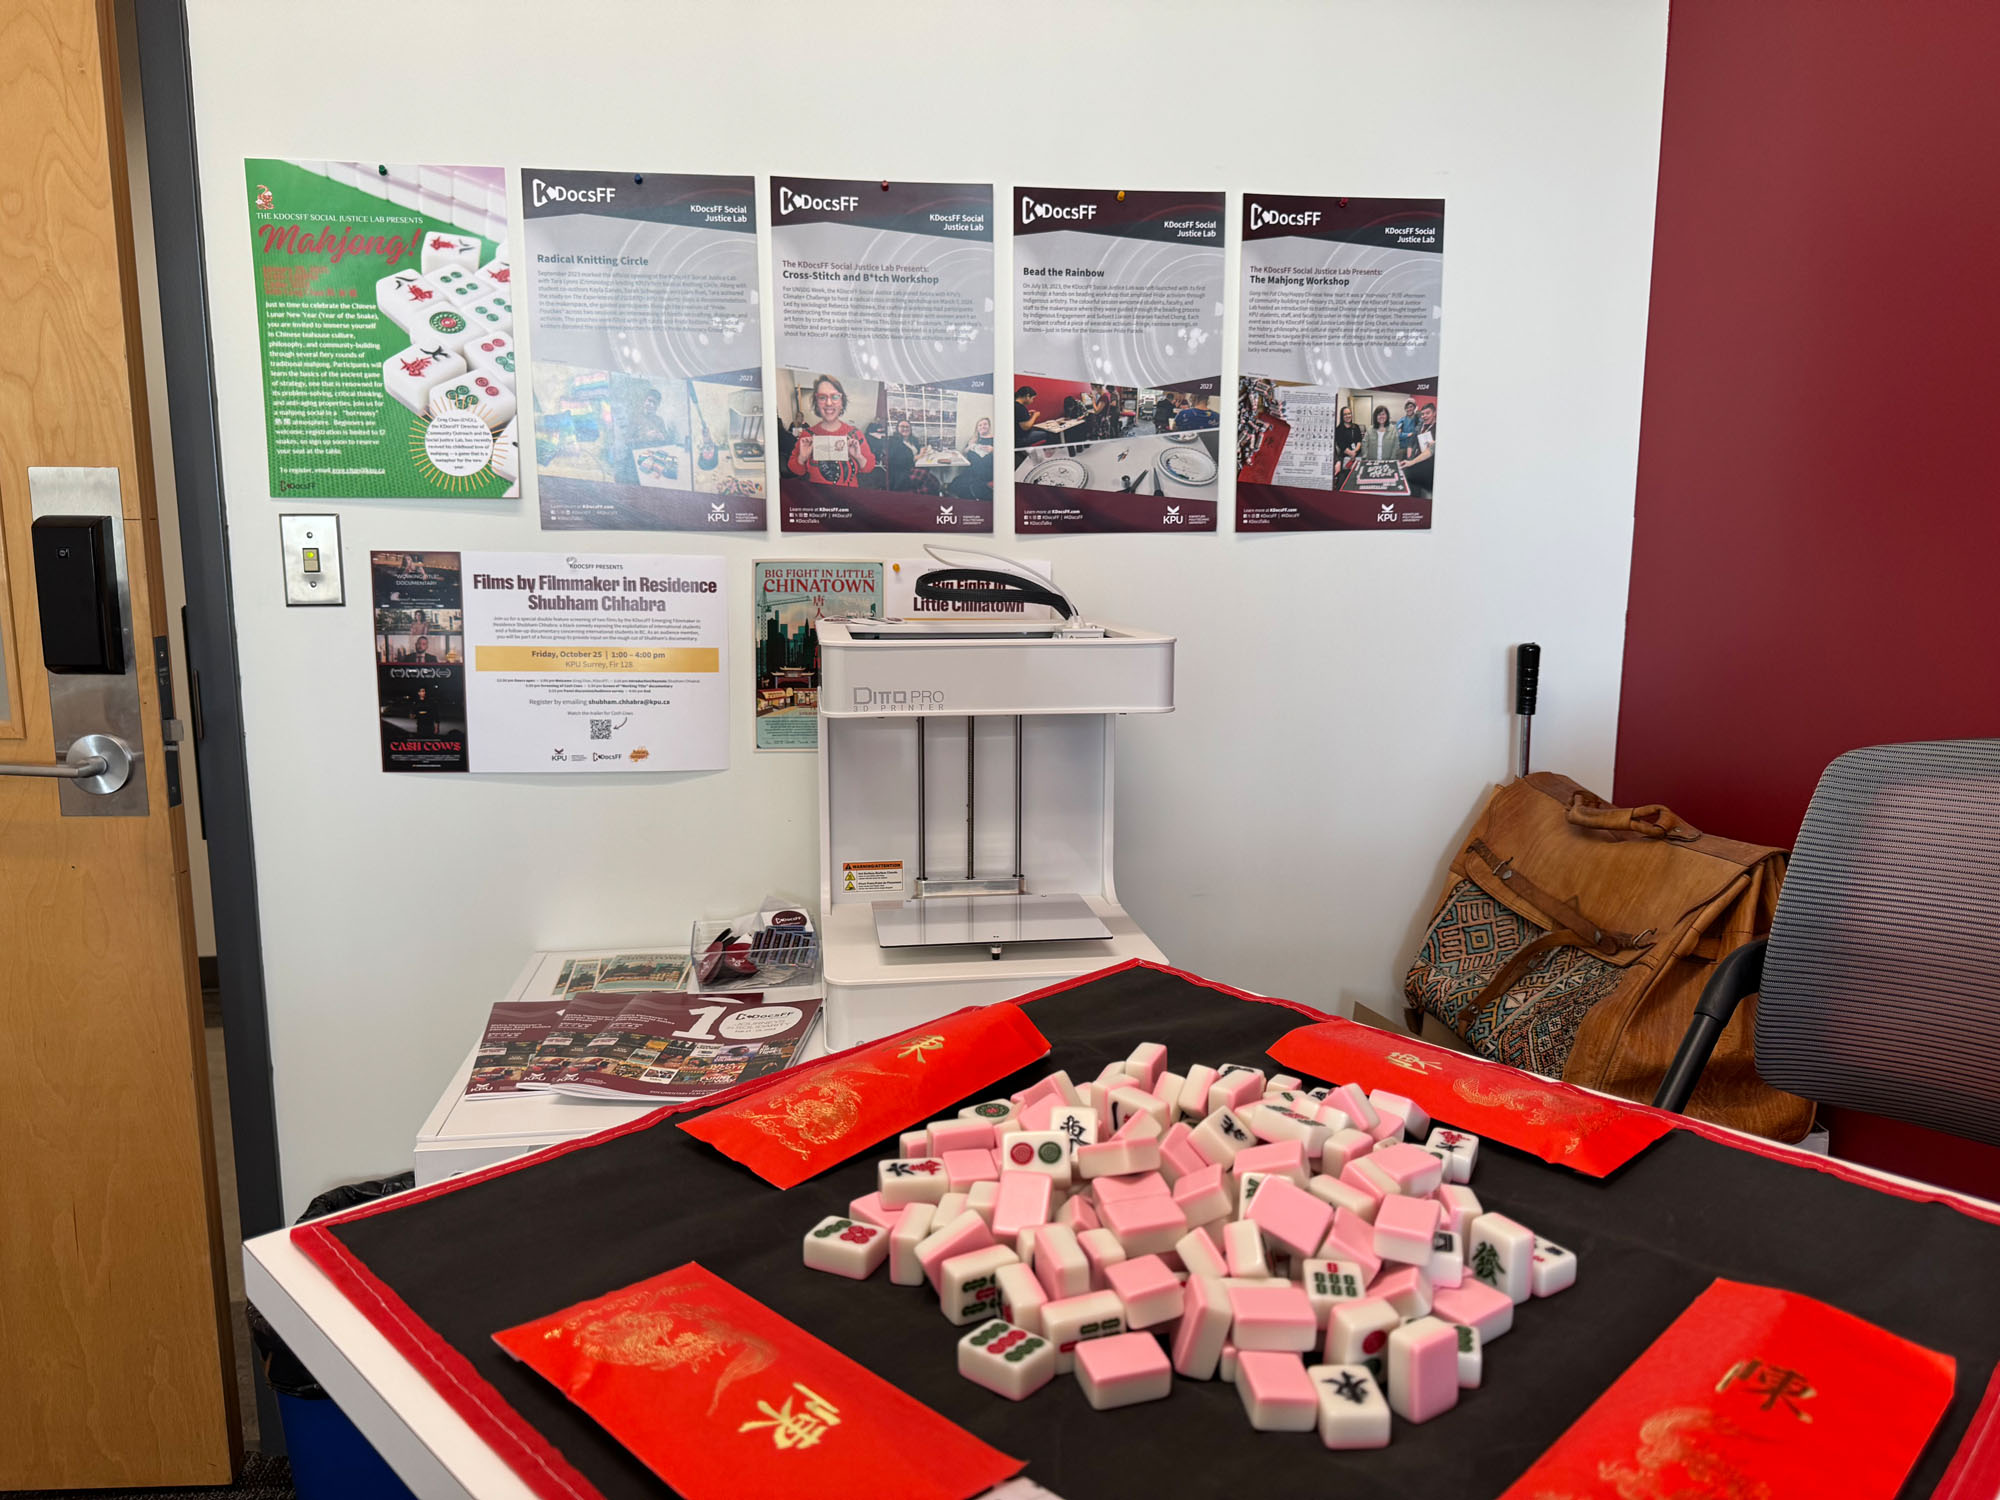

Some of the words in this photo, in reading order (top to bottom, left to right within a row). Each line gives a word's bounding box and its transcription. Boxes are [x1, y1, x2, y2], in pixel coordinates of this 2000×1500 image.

[691, 205, 722, 213] KDocsFF
[724, 205, 747, 214] Social
[705, 214, 732, 222] Justice
[930, 214, 960, 222] KDocsFF
[962, 215, 984, 223] Social
[943, 223, 969, 231] Justice
[1164, 221, 1194, 229] KDocsFF
[1195, 221, 1216, 229] Social
[1177, 230, 1202, 238] Justice
[1203, 230, 1216, 238] Lab
[1385, 227, 1414, 235] KDocsFF
[1415, 227, 1435, 235] Social
[258, 224, 421, 265] Mahjong!
[537, 254, 574, 264] Radical
[576, 255, 618, 266] Knitting
[620, 256, 648, 266] Circle
[782, 260, 796, 268] The
[798, 261, 828, 269] KDocsFF
[1023, 267, 1045, 276] Bead
[1048, 268, 1063, 276] the
[1065, 268, 1104, 277] Rainbow
[783, 270, 841, 281] Cross-Stitch
[843, 273, 860, 282] and
[892, 274, 939, 285] Workshop
[1250, 275, 1265, 284] The
[1268, 276, 1304, 286] Mahjong
[1306, 277, 1349, 287] Workshop
[708, 513, 730, 522] KPU
[937, 516, 957, 524] KPU
[1163, 515, 1183, 525] KPU
[1377, 513, 1397, 522] KPU
[765, 569, 783, 578] BIG
[786, 569, 820, 578] FIGHT
[822, 569, 836, 578] IN
[836, 569, 874, 578] LITTLE
[473, 574, 514, 590] Films
[517, 574, 536, 593] by
[539, 575, 620, 592] Filmmaker
[623, 576, 636, 592] in
[639, 577, 717, 593] Residence
[764, 579, 875, 592] CHINATOWN
[528, 594, 598, 611] Shubham
[602, 596, 666, 612] Chhabra
[913, 597, 949, 612] Little
[952, 600, 1024, 612] Chinatown
[911, 691, 944, 703] PRO
[881, 704, 944, 712] PRINTER
[423, 742, 461, 751] COWS
